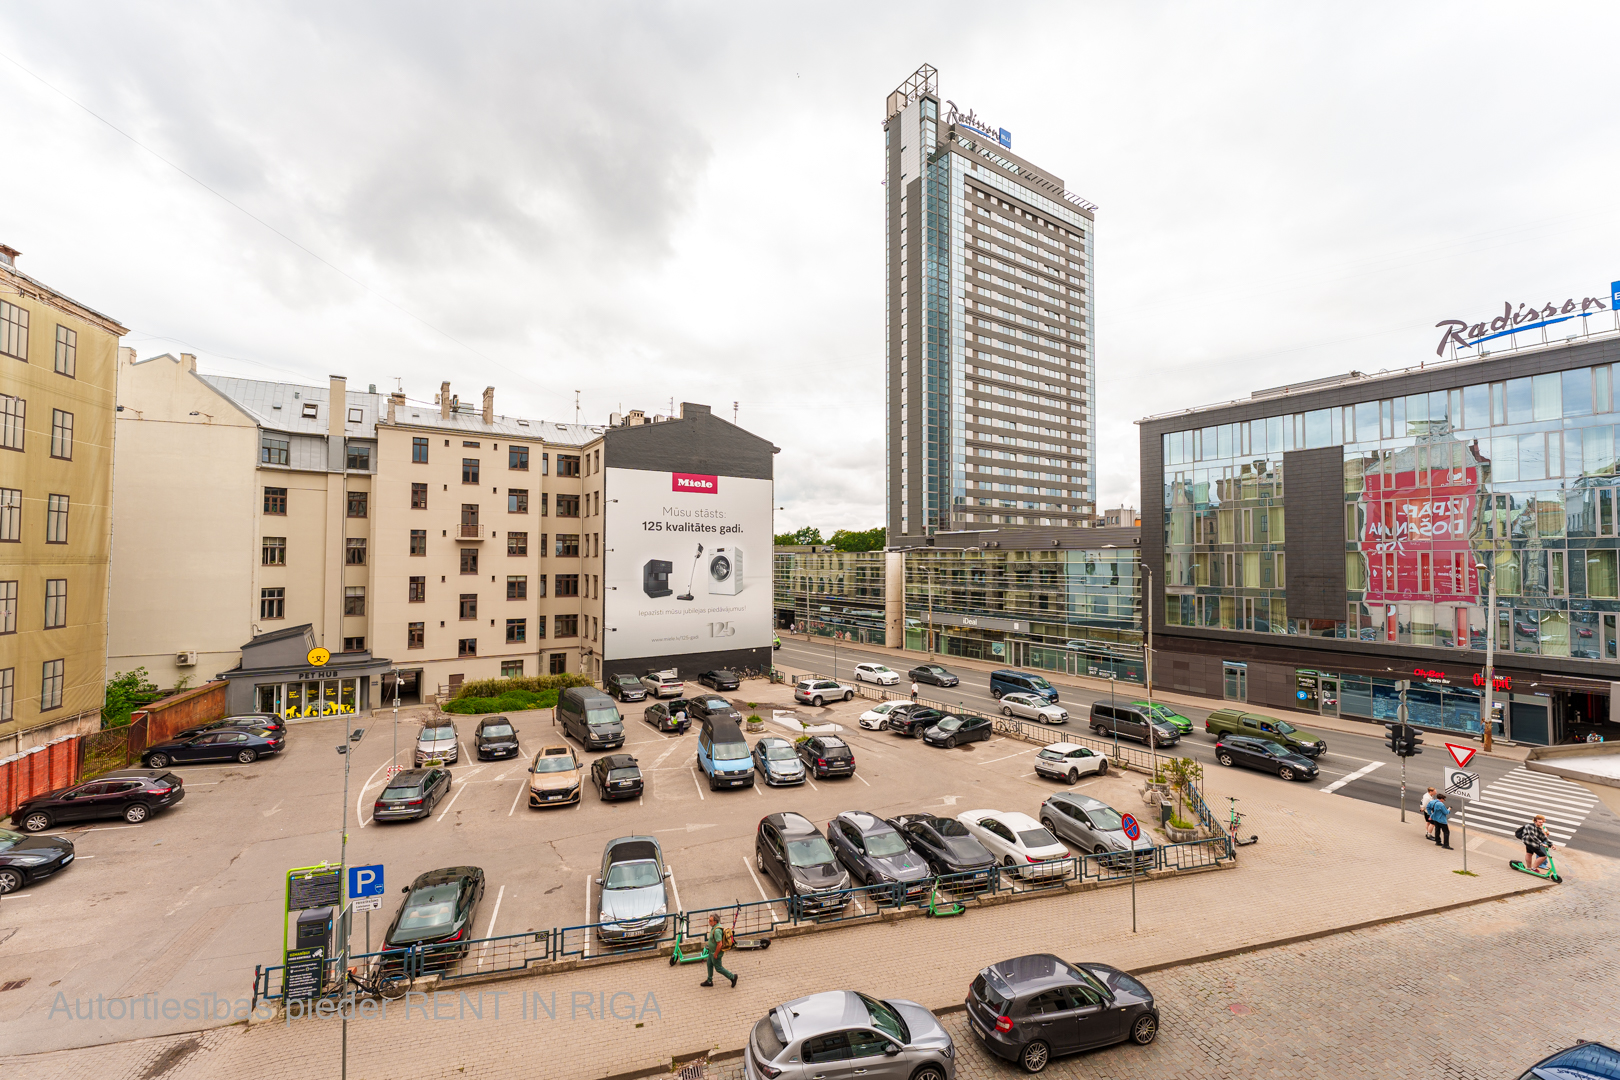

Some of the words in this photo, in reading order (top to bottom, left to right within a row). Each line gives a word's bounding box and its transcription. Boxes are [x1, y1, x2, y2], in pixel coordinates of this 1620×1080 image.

[946, 100, 999, 140] Radisson
[1435, 297, 1606, 357] Radisson
[678, 478, 713, 488] Miele
[662, 506, 692, 517] Mūsu
[694, 508, 727, 519] stāsts:
[642, 521, 663, 531] 125
[666, 521, 717, 533] kvalitātes
[720, 523, 744, 535] gadi.
[683, 607, 707, 616] jubilejas
[963, 617, 978, 626] iDeal
[706, 620, 736, 638] 125
[1413, 668, 1446, 679] OlyBet
[357, 870, 376, 894] P
